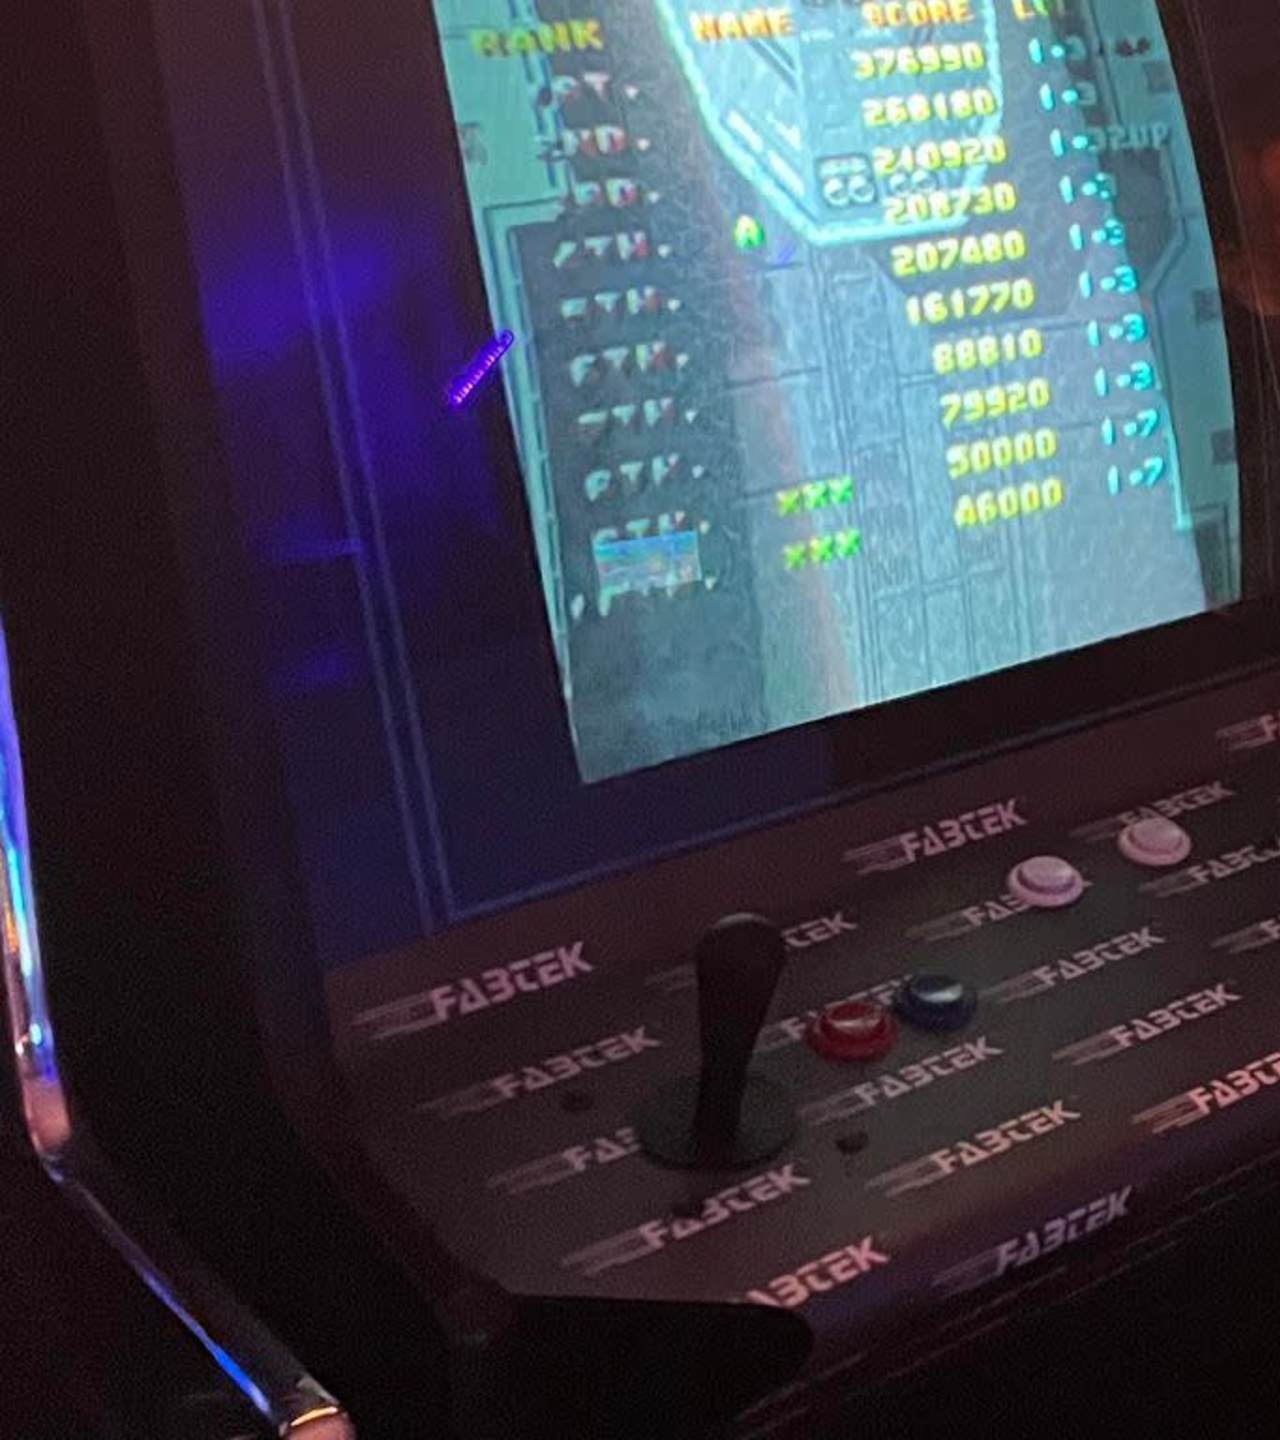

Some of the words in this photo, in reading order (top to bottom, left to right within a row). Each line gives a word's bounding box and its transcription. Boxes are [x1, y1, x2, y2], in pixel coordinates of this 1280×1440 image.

[690, 7, 795, 42] NAME
[849, 41, 987, 81] 376990
[891, 229, 1026, 277] 207480
[904, 276, 1036, 326] 161770
[933, 327, 1044, 375] 88810
[940, 377, 1050, 429] 79920
[945, 427, 1058, 479] 50000
[953, 476, 1064, 529] 46000
[899, 798, 1028, 861] FABTEK
[428, 940, 595, 1022] FABTEK
[1032, 926, 1167, 989] FABTEK
[1110, 982, 1243, 1050] FABTEK
[494, 1025, 662, 1100] FABTEK
[855, 1036, 1004, 1108] FABTEK
[928, 1099, 1082, 1174] FABTEK
[640, 1162, 812, 1250] FABTEK
[996, 1186, 1136, 1270] FABTEK
